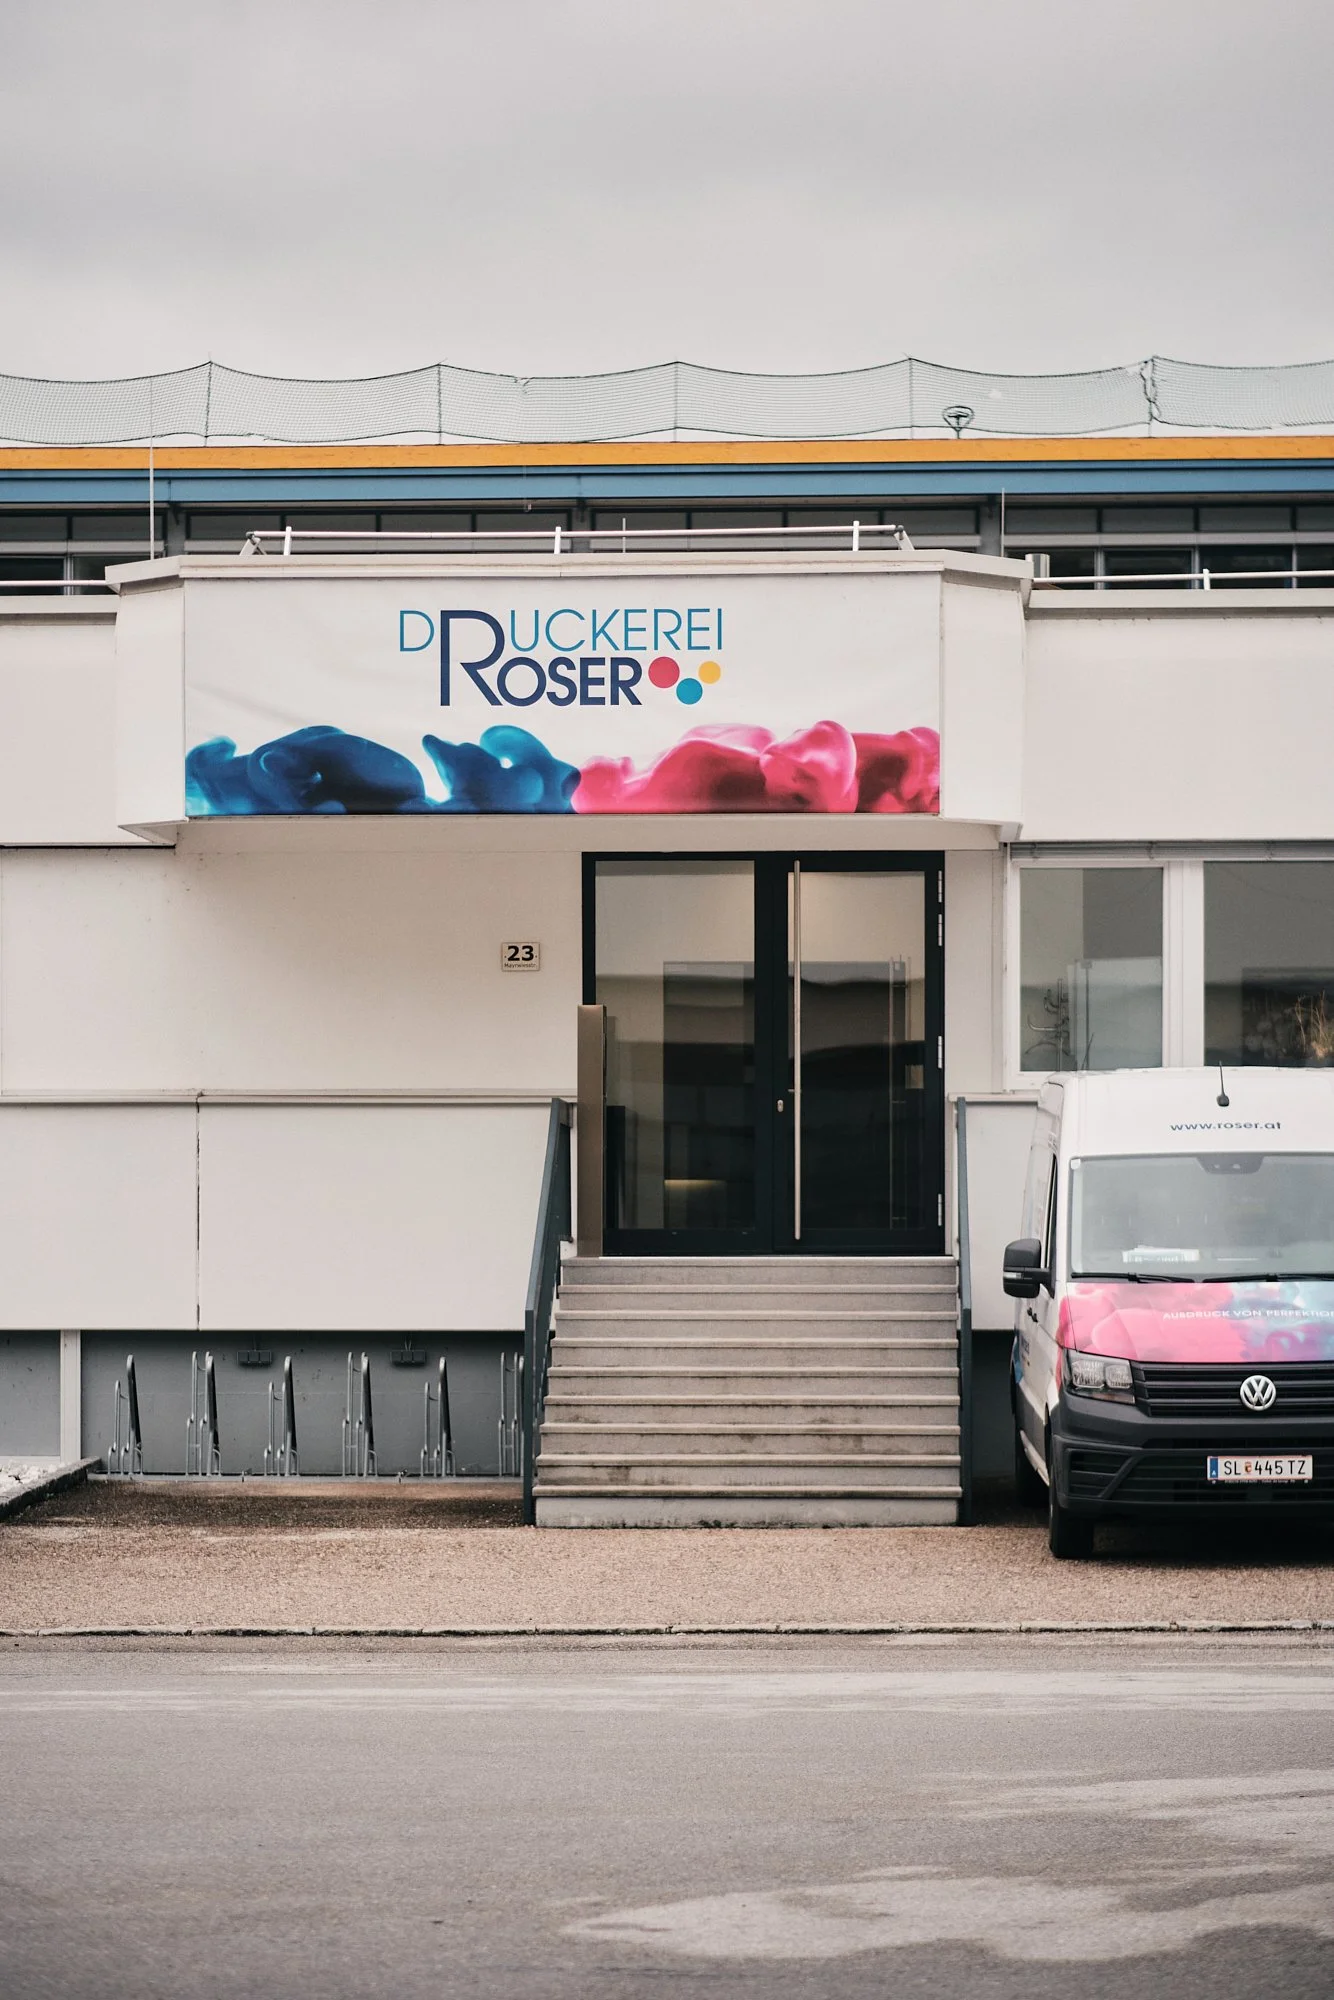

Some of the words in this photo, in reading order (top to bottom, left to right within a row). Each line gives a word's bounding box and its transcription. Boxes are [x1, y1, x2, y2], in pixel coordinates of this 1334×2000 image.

[399, 608, 723, 652] DRUCKEREI
[440, 610, 643, 706] ROSER
[507, 945, 534, 962] 23
[1170, 1122, 1281, 1131] www.roser.at
[1163, 1310, 1230, 1320] AUSDRUCK
[1240, 1375, 1276, 1411] VW
[1223, 1461, 1241, 1475] SL
[1254, 1461, 1283, 1475] 445
[1287, 1460, 1306, 1475] TZ
